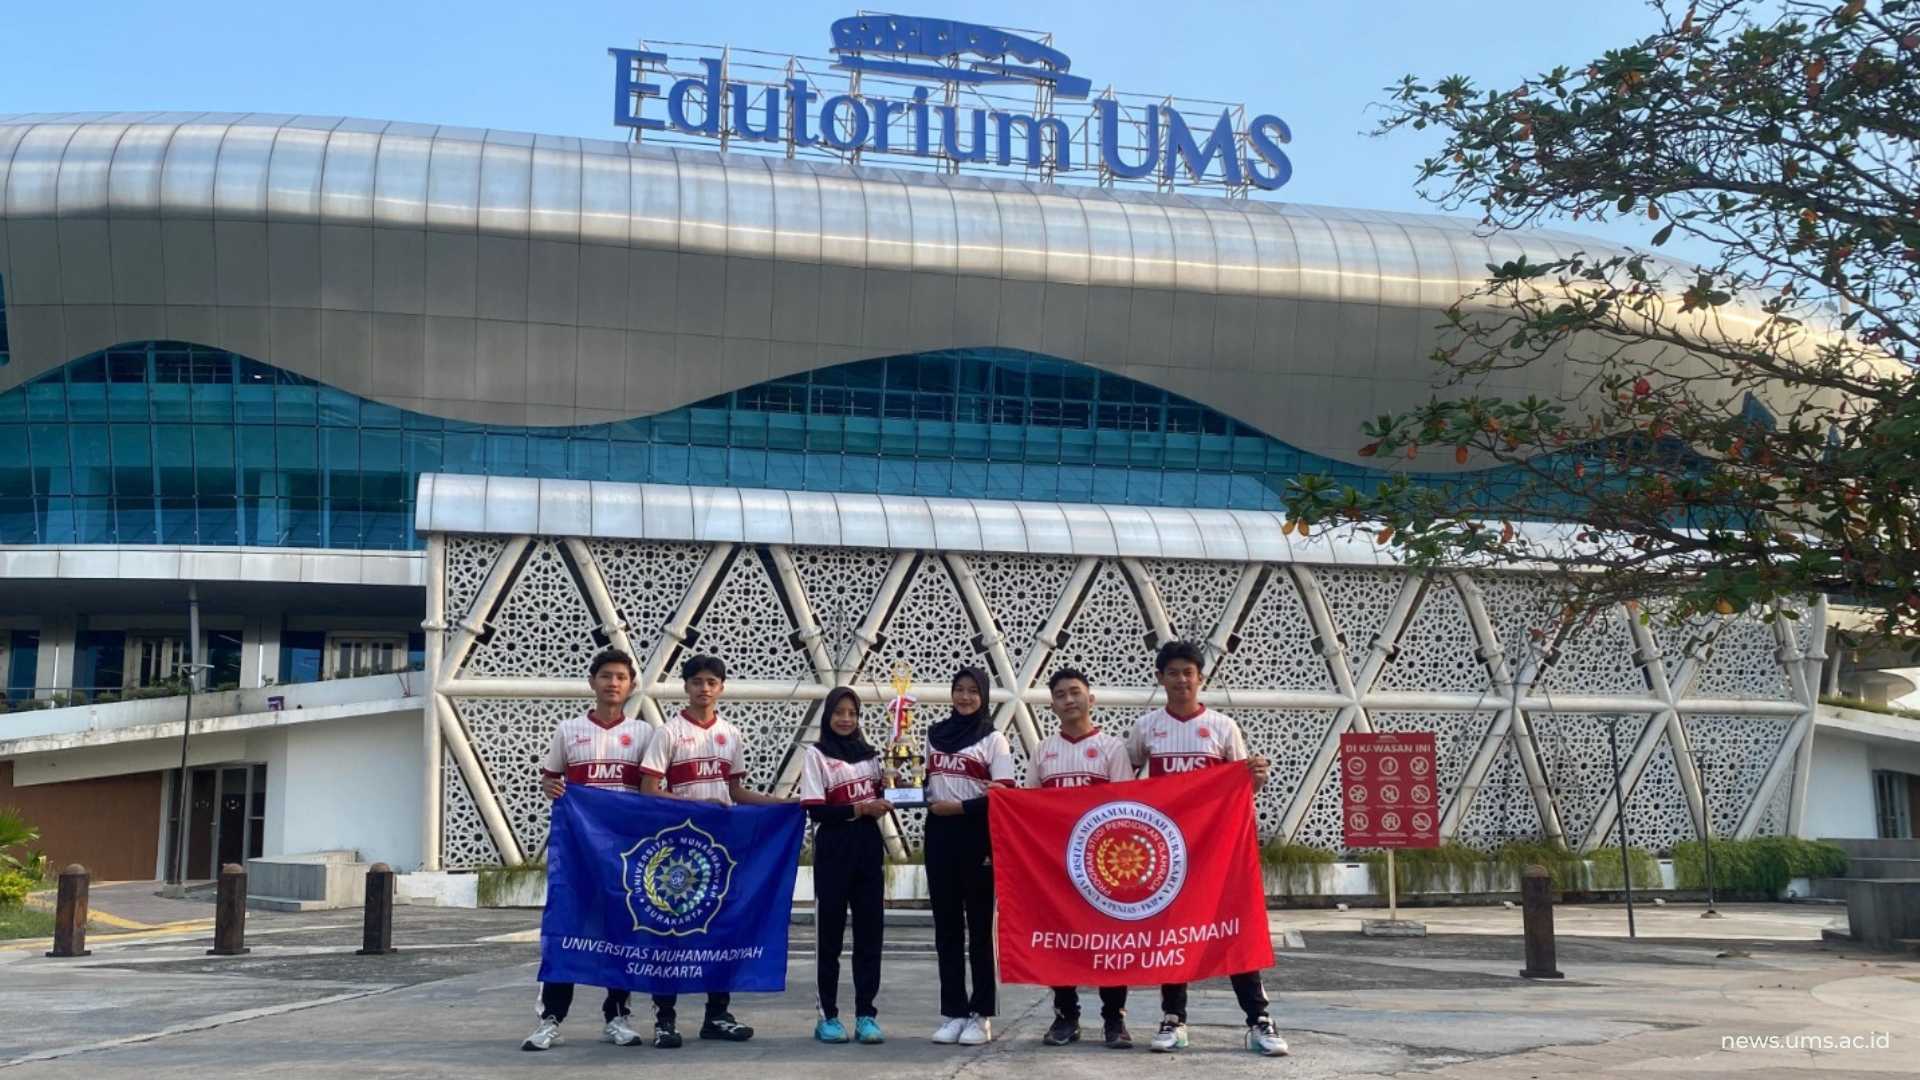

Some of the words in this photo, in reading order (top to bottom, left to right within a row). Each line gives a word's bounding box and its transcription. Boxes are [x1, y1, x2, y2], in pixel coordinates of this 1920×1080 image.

[607, 47, 1070, 171] Edutorium
[1094, 96, 1292, 191] UMS
[1346, 744, 1357, 753] DI
[1359, 744, 1412, 753] KAWASAN
[1415, 744, 1431, 753] INI
[588, 764, 624, 779] UMS
[934, 754, 966, 771] UMS
[1163, 757, 1206, 773] UMS
[1081, 807, 1168, 833] MUHAMMADIYAH
[1105, 821, 1160, 842] PENDIDIKAN
[1087, 827, 1106, 854] STUDI
[634, 838, 674, 894] UNIVERSITAS
[680, 837, 721, 898] MUHAMMADIYAH
[1073, 836, 1100, 901] UNIVERSITAS
[1086, 854, 1112, 895] PROGRAM
[1162, 830, 1180, 894] SURAKARTA
[644, 904, 704, 925] SURAKARTA
[1031, 930, 1152, 951] PENDIDIKAN
[1156, 918, 1240, 947] JASMANI
[561, 936, 649, 960] UNIVERSITAS
[651, 946, 764, 963] MUHAMMADIYAH
[1093, 953, 1135, 970] FKIP
[1141, 949, 1186, 969] UMS
[625, 962, 703, 978] SURAKARTA
